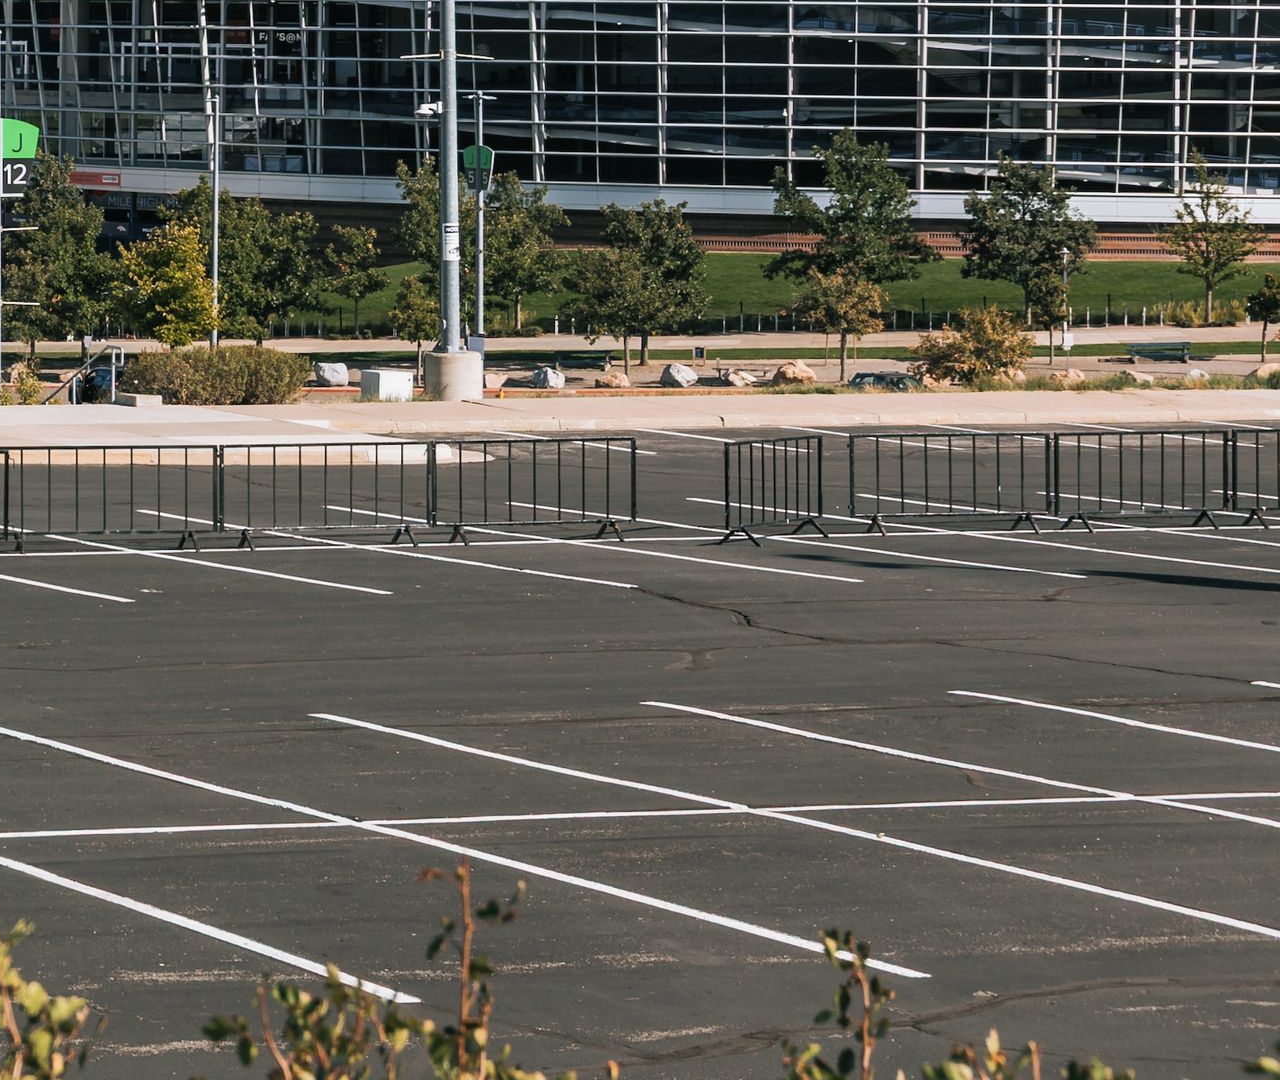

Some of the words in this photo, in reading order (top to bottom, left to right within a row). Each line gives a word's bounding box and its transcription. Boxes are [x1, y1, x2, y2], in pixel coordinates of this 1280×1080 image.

[12, 132, 23, 153] J
[469, 153, 474, 165] J
[483, 153, 488, 165] J
[3, 163, 27, 185] 12
[468, 171, 475, 183] 5
[482, 172, 488, 184] 5
[107, 196, 131, 207] MILE
